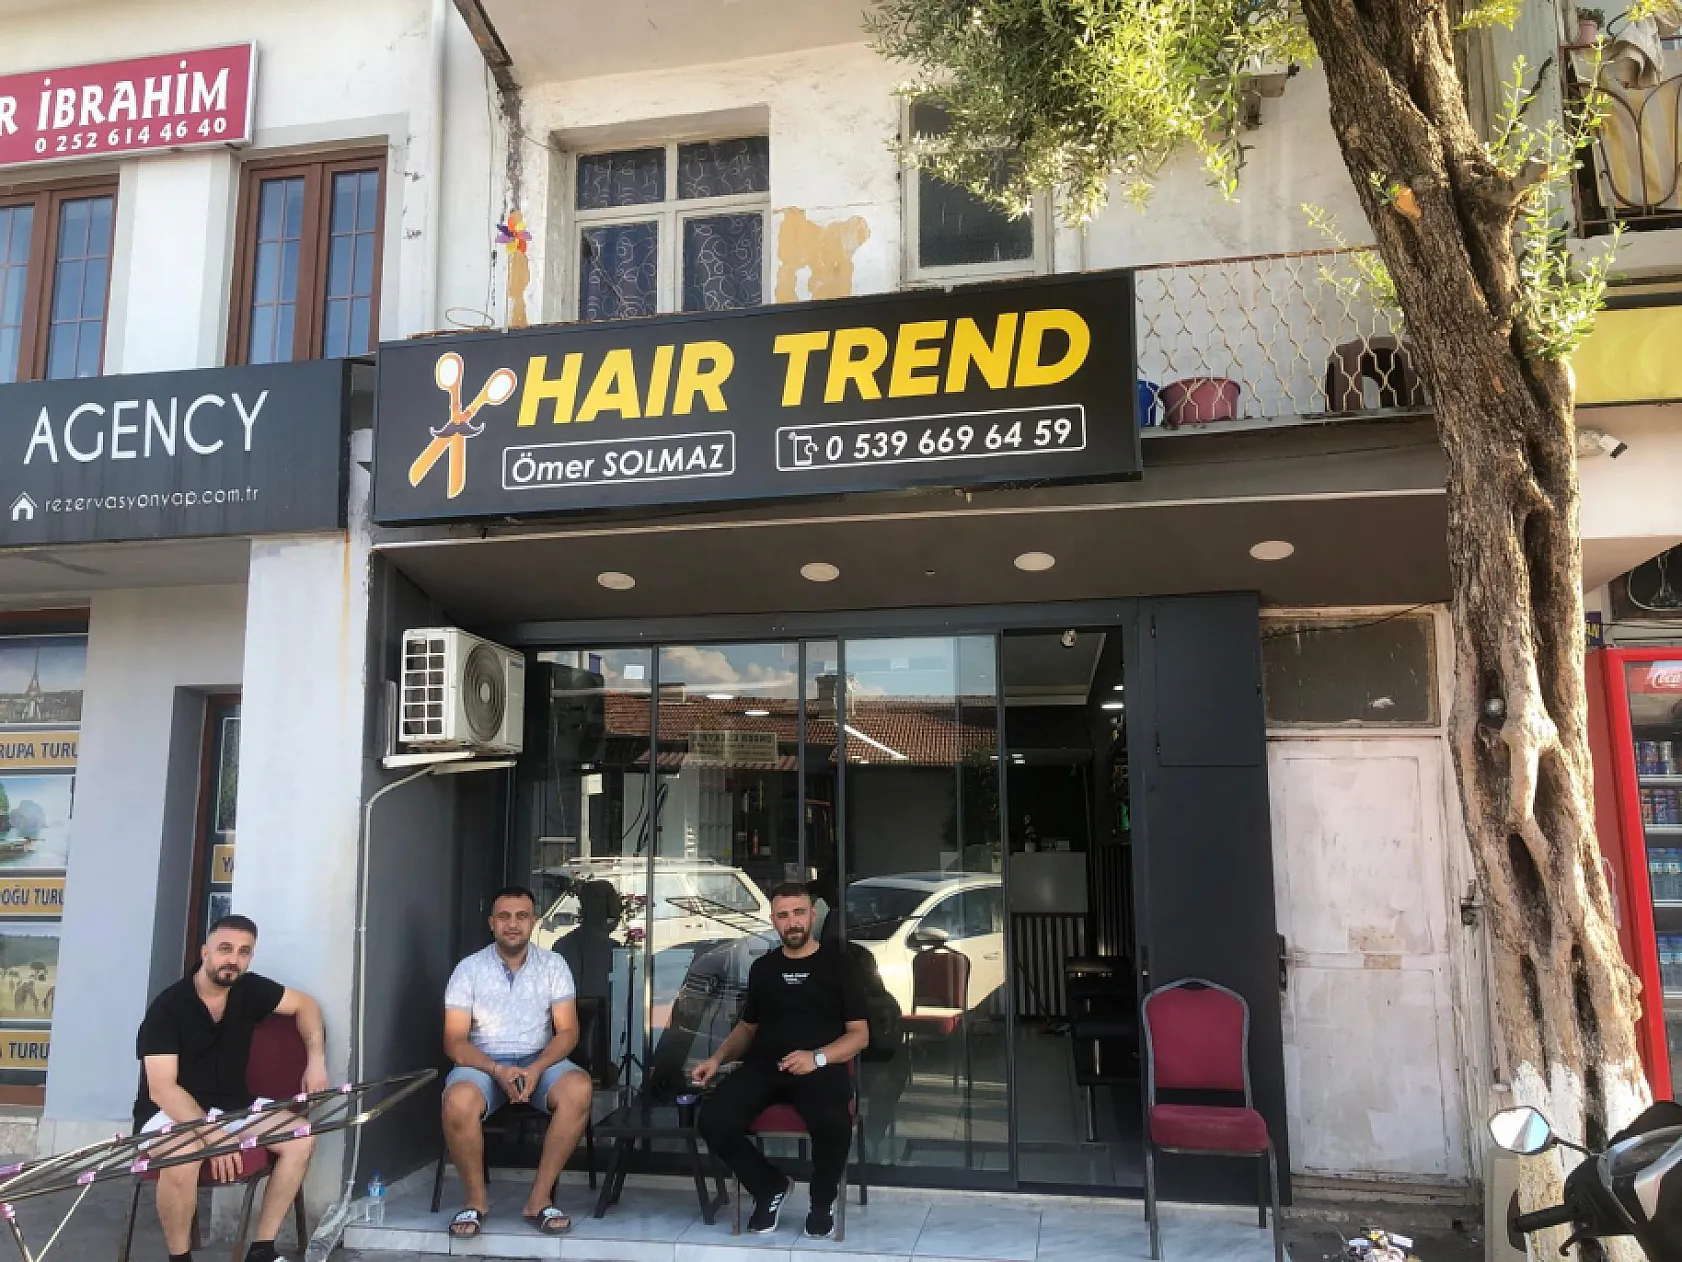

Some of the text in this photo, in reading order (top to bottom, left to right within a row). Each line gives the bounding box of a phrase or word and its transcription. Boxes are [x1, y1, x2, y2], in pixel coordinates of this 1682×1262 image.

[37, 60, 230, 131] İBRAHİM
[35, 117, 227, 153] 0 252 614 46 40
[517, 308, 1091, 427] HAIR TREND
[23, 389, 269, 464] AGENCY
[825, 418, 1072, 461] 0 539 669 64 59
[512, 444, 724, 482] Ömer SOLMAZ
[45, 486, 259, 512] rezervasyonyap.com.tr
[9, 1042, 50, 1058] TURU
